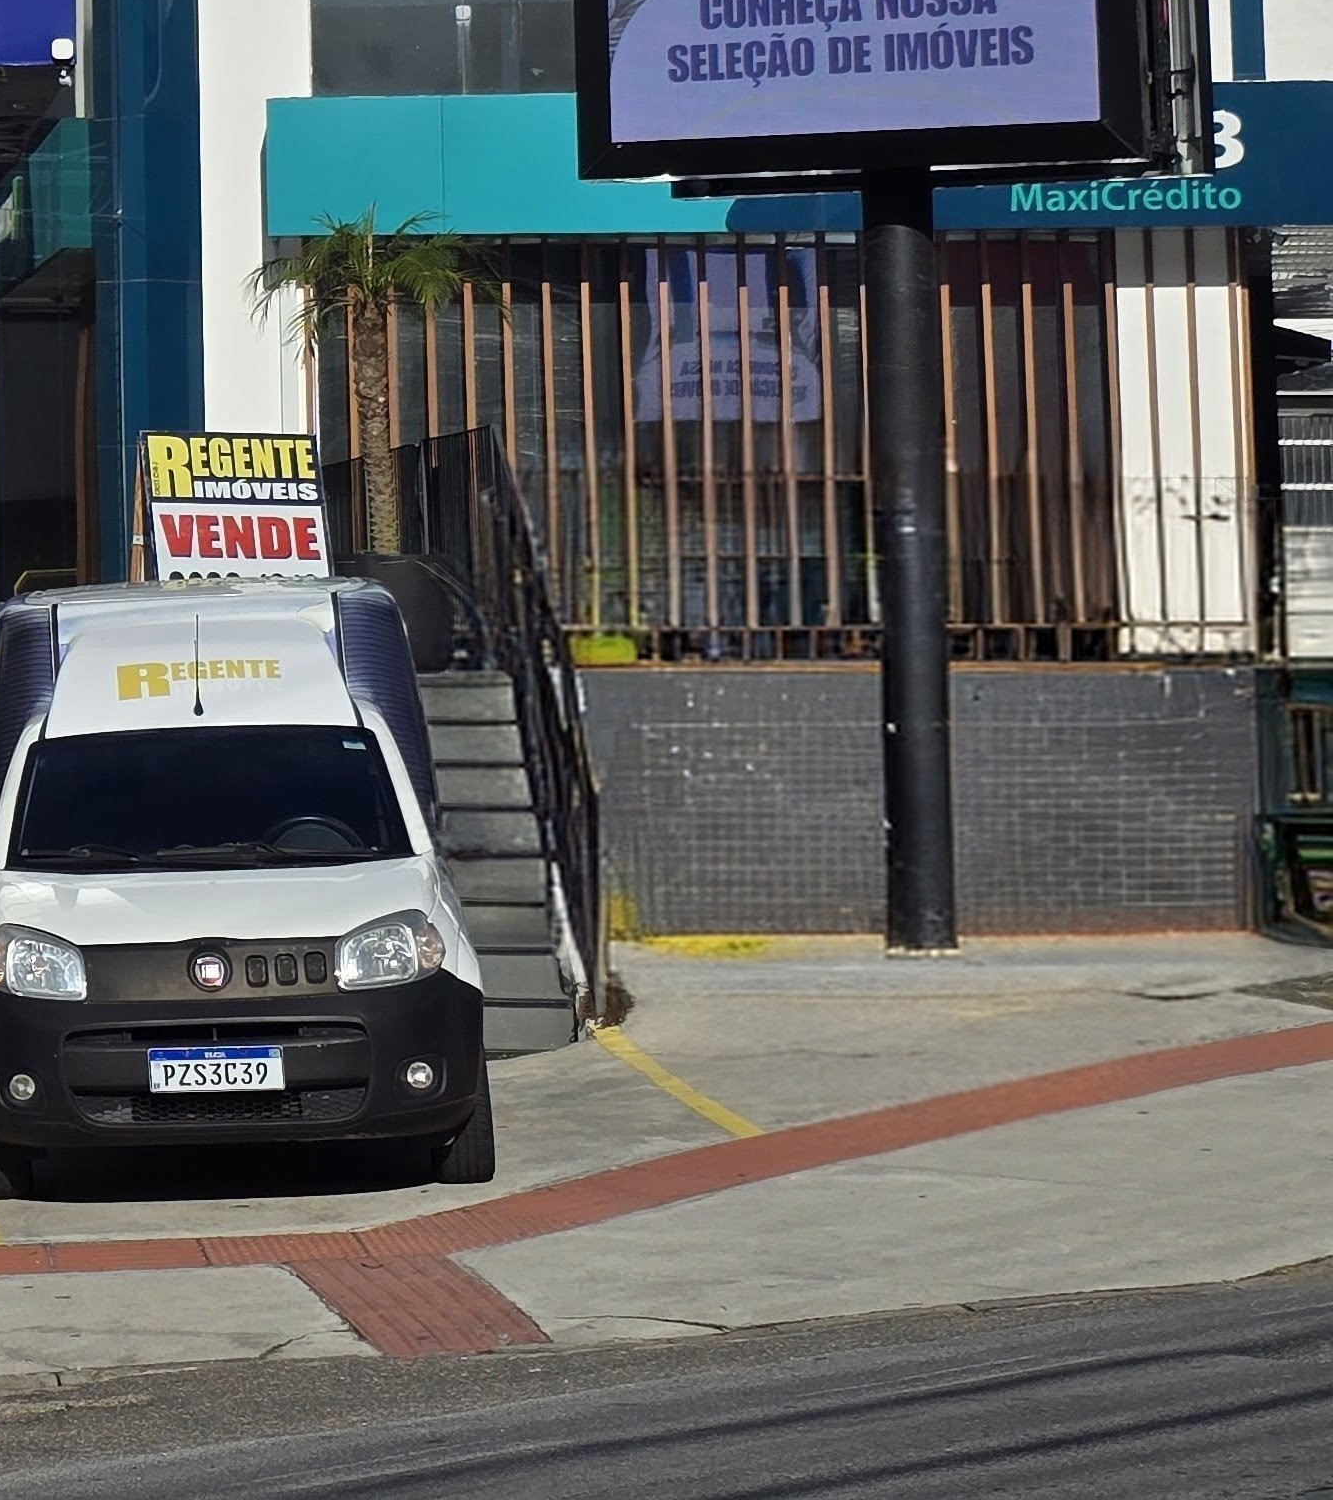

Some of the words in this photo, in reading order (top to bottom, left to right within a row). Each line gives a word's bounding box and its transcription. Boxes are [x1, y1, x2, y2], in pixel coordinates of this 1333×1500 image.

[667, 32, 815, 88] SELEÇÃO
[828, 35, 872, 74] DE
[884, 22, 1035, 72] IMÓVEIS
[1010, 180, 1242, 212] MaxiCrédito
[147, 435, 316, 498] REGENTE
[193, 478, 319, 501] IMÓVEIS
[159, 513, 322, 561] VENDE
[116, 659, 282, 701] REGENTE
[162, 1062, 269, 1087] PZS3C39
